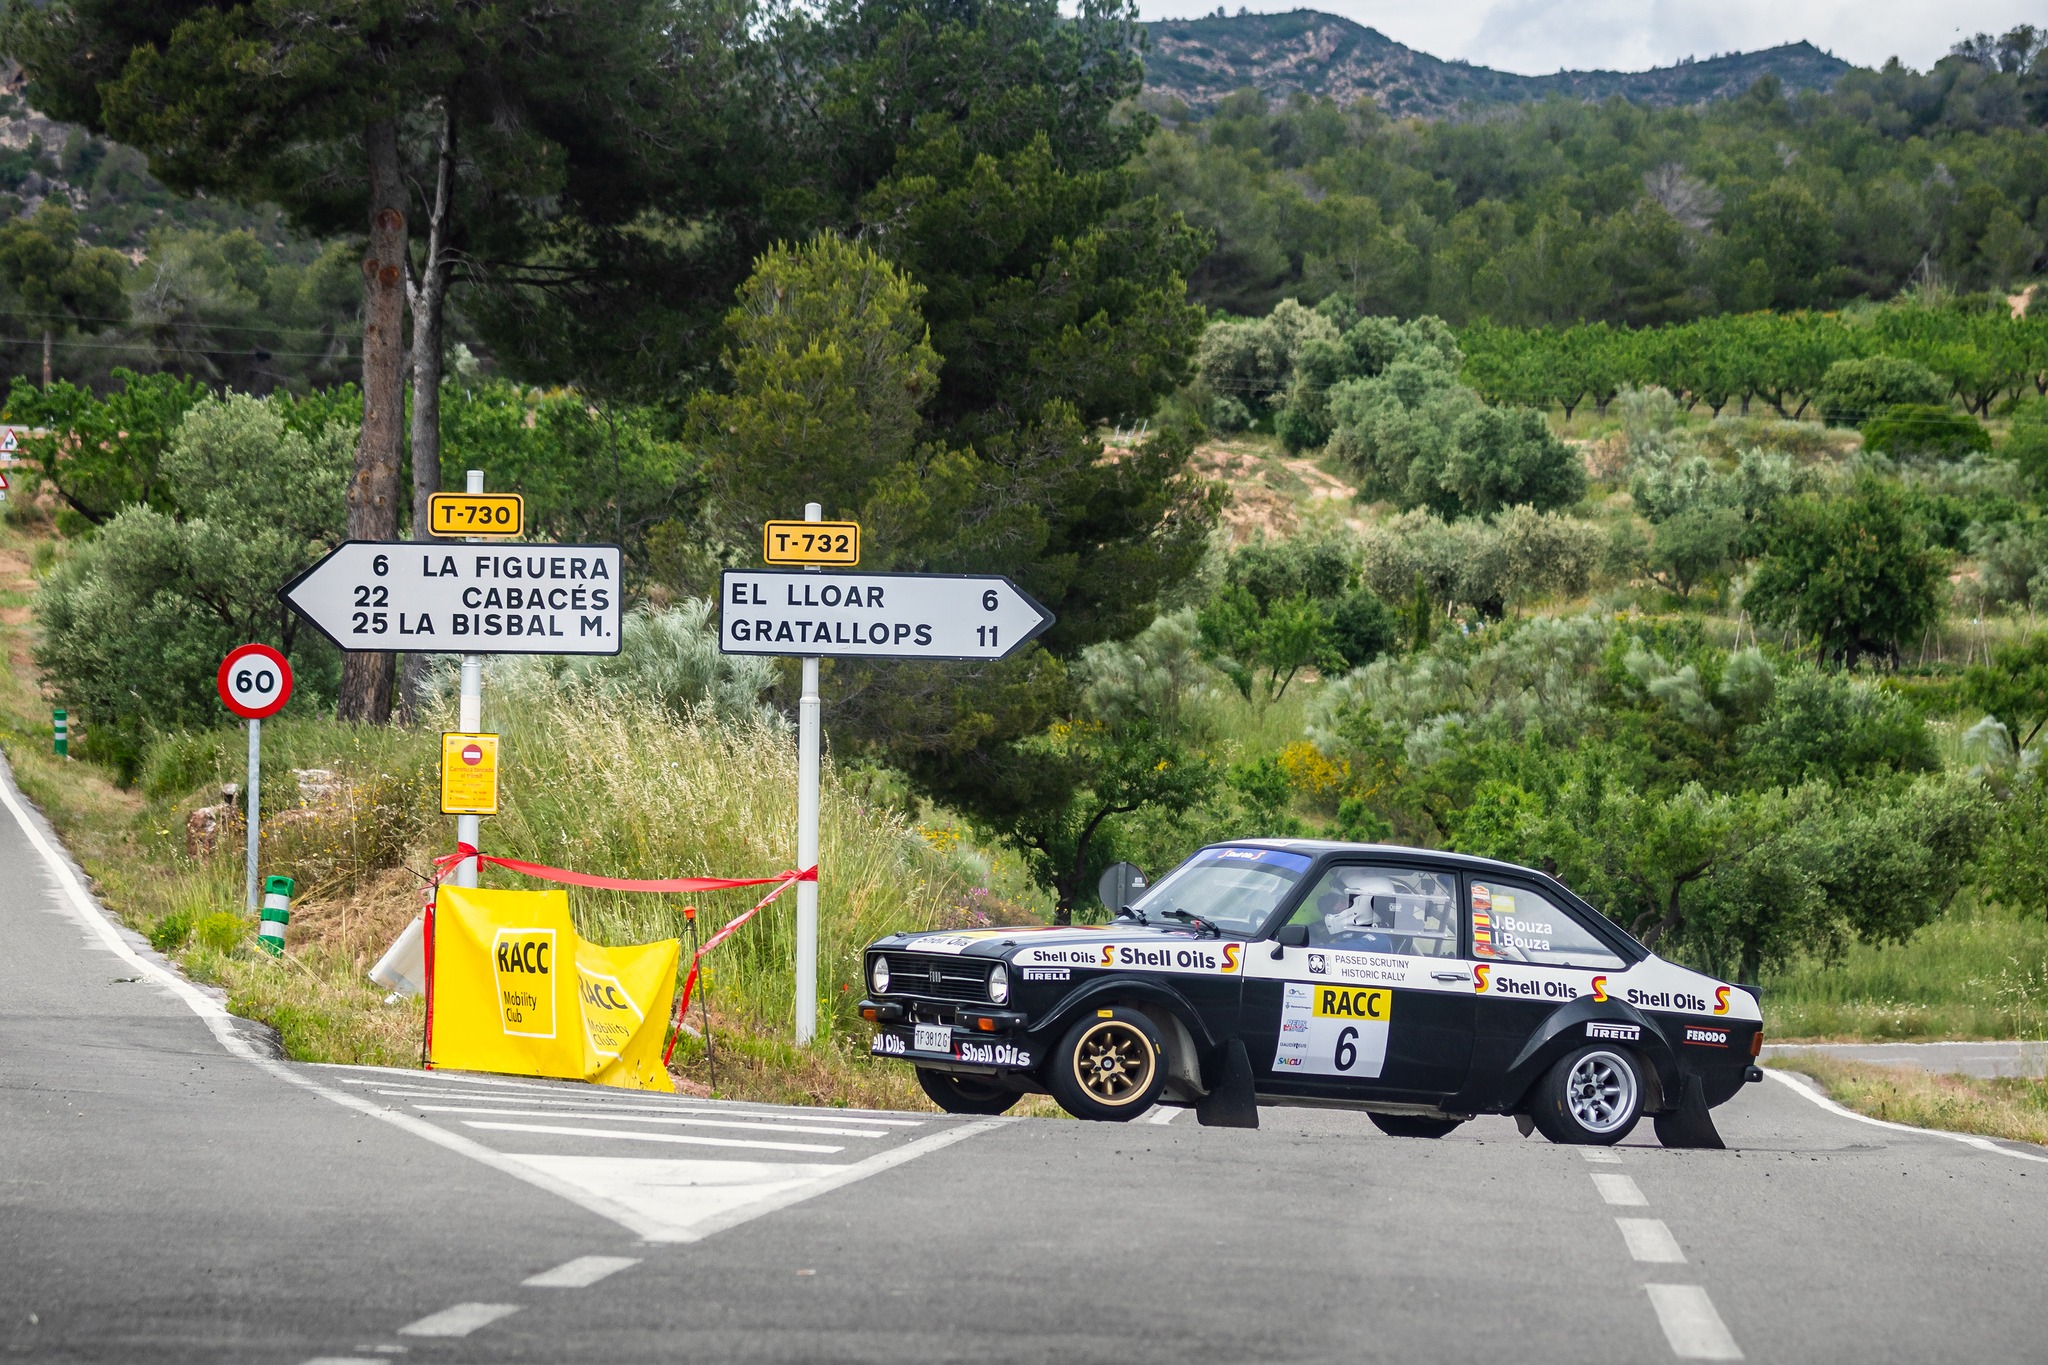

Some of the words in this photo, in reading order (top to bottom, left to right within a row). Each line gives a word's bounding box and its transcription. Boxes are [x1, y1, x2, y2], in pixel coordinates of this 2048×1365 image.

[441, 506, 510, 525] T-730
[775, 533, 849, 553] T-732
[373, 554, 389, 577] 6
[423, 555, 458, 578] LA
[475, 556, 609, 580] FIGUERA
[354, 585, 389, 608] 22
[463, 584, 609, 610] CABACÉS
[731, 583, 767, 605] EL
[788, 584, 885, 608] LLOAR
[982, 589, 999, 612] 6
[352, 612, 388, 634] 25
[400, 613, 435, 635] LA
[452, 613, 564, 636] BISBAL
[580, 616, 611, 638] M.
[731, 619, 932, 646] GRATALLOPS
[976, 625, 998, 647] 11
[236, 670, 274, 693] 60
[1491, 915, 1553, 935] J.Bouza
[1495, 932, 1550, 951] I.Bouza
[498, 941, 549, 974] RACC
[1033, 950, 1067, 963] Shell
[1070, 951, 1096, 963] Oils
[1120, 947, 1171, 967] Shell
[1177, 949, 1216, 969] Oils
[1335, 955, 1367, 966] PASSED
[1370, 957, 1410, 969] SCRUTINY
[1023, 967, 1071, 981] PIRELLI
[1341, 968, 1379, 979] HISTORIC
[1382, 971, 1406, 981] RALLY
[504, 990, 537, 1014] Mobility
[578, 973, 628, 1010] RACC
[1496, 977, 1540, 996] Shell
[1544, 980, 1577, 999] Oils
[1627, 988, 1670, 1007] Shell
[1674, 993, 1706, 1011] Oils
[1322, 989, 1381, 1018] RACC
[506, 1008, 523, 1024] Club
[587, 1017, 630, 1037] Mobility
[593, 1033, 618, 1046] Club
[1586, 1022, 1640, 1041] PIRELLI
[1686, 1029, 1727, 1044] FERODO
[872, 1033, 884, 1051] ell
[886, 1034, 905, 1054] Oils
[962, 1042, 992, 1062] Shell
[996, 1044, 1031, 1066] Oils
[1334, 1026, 1359, 1072] 6
